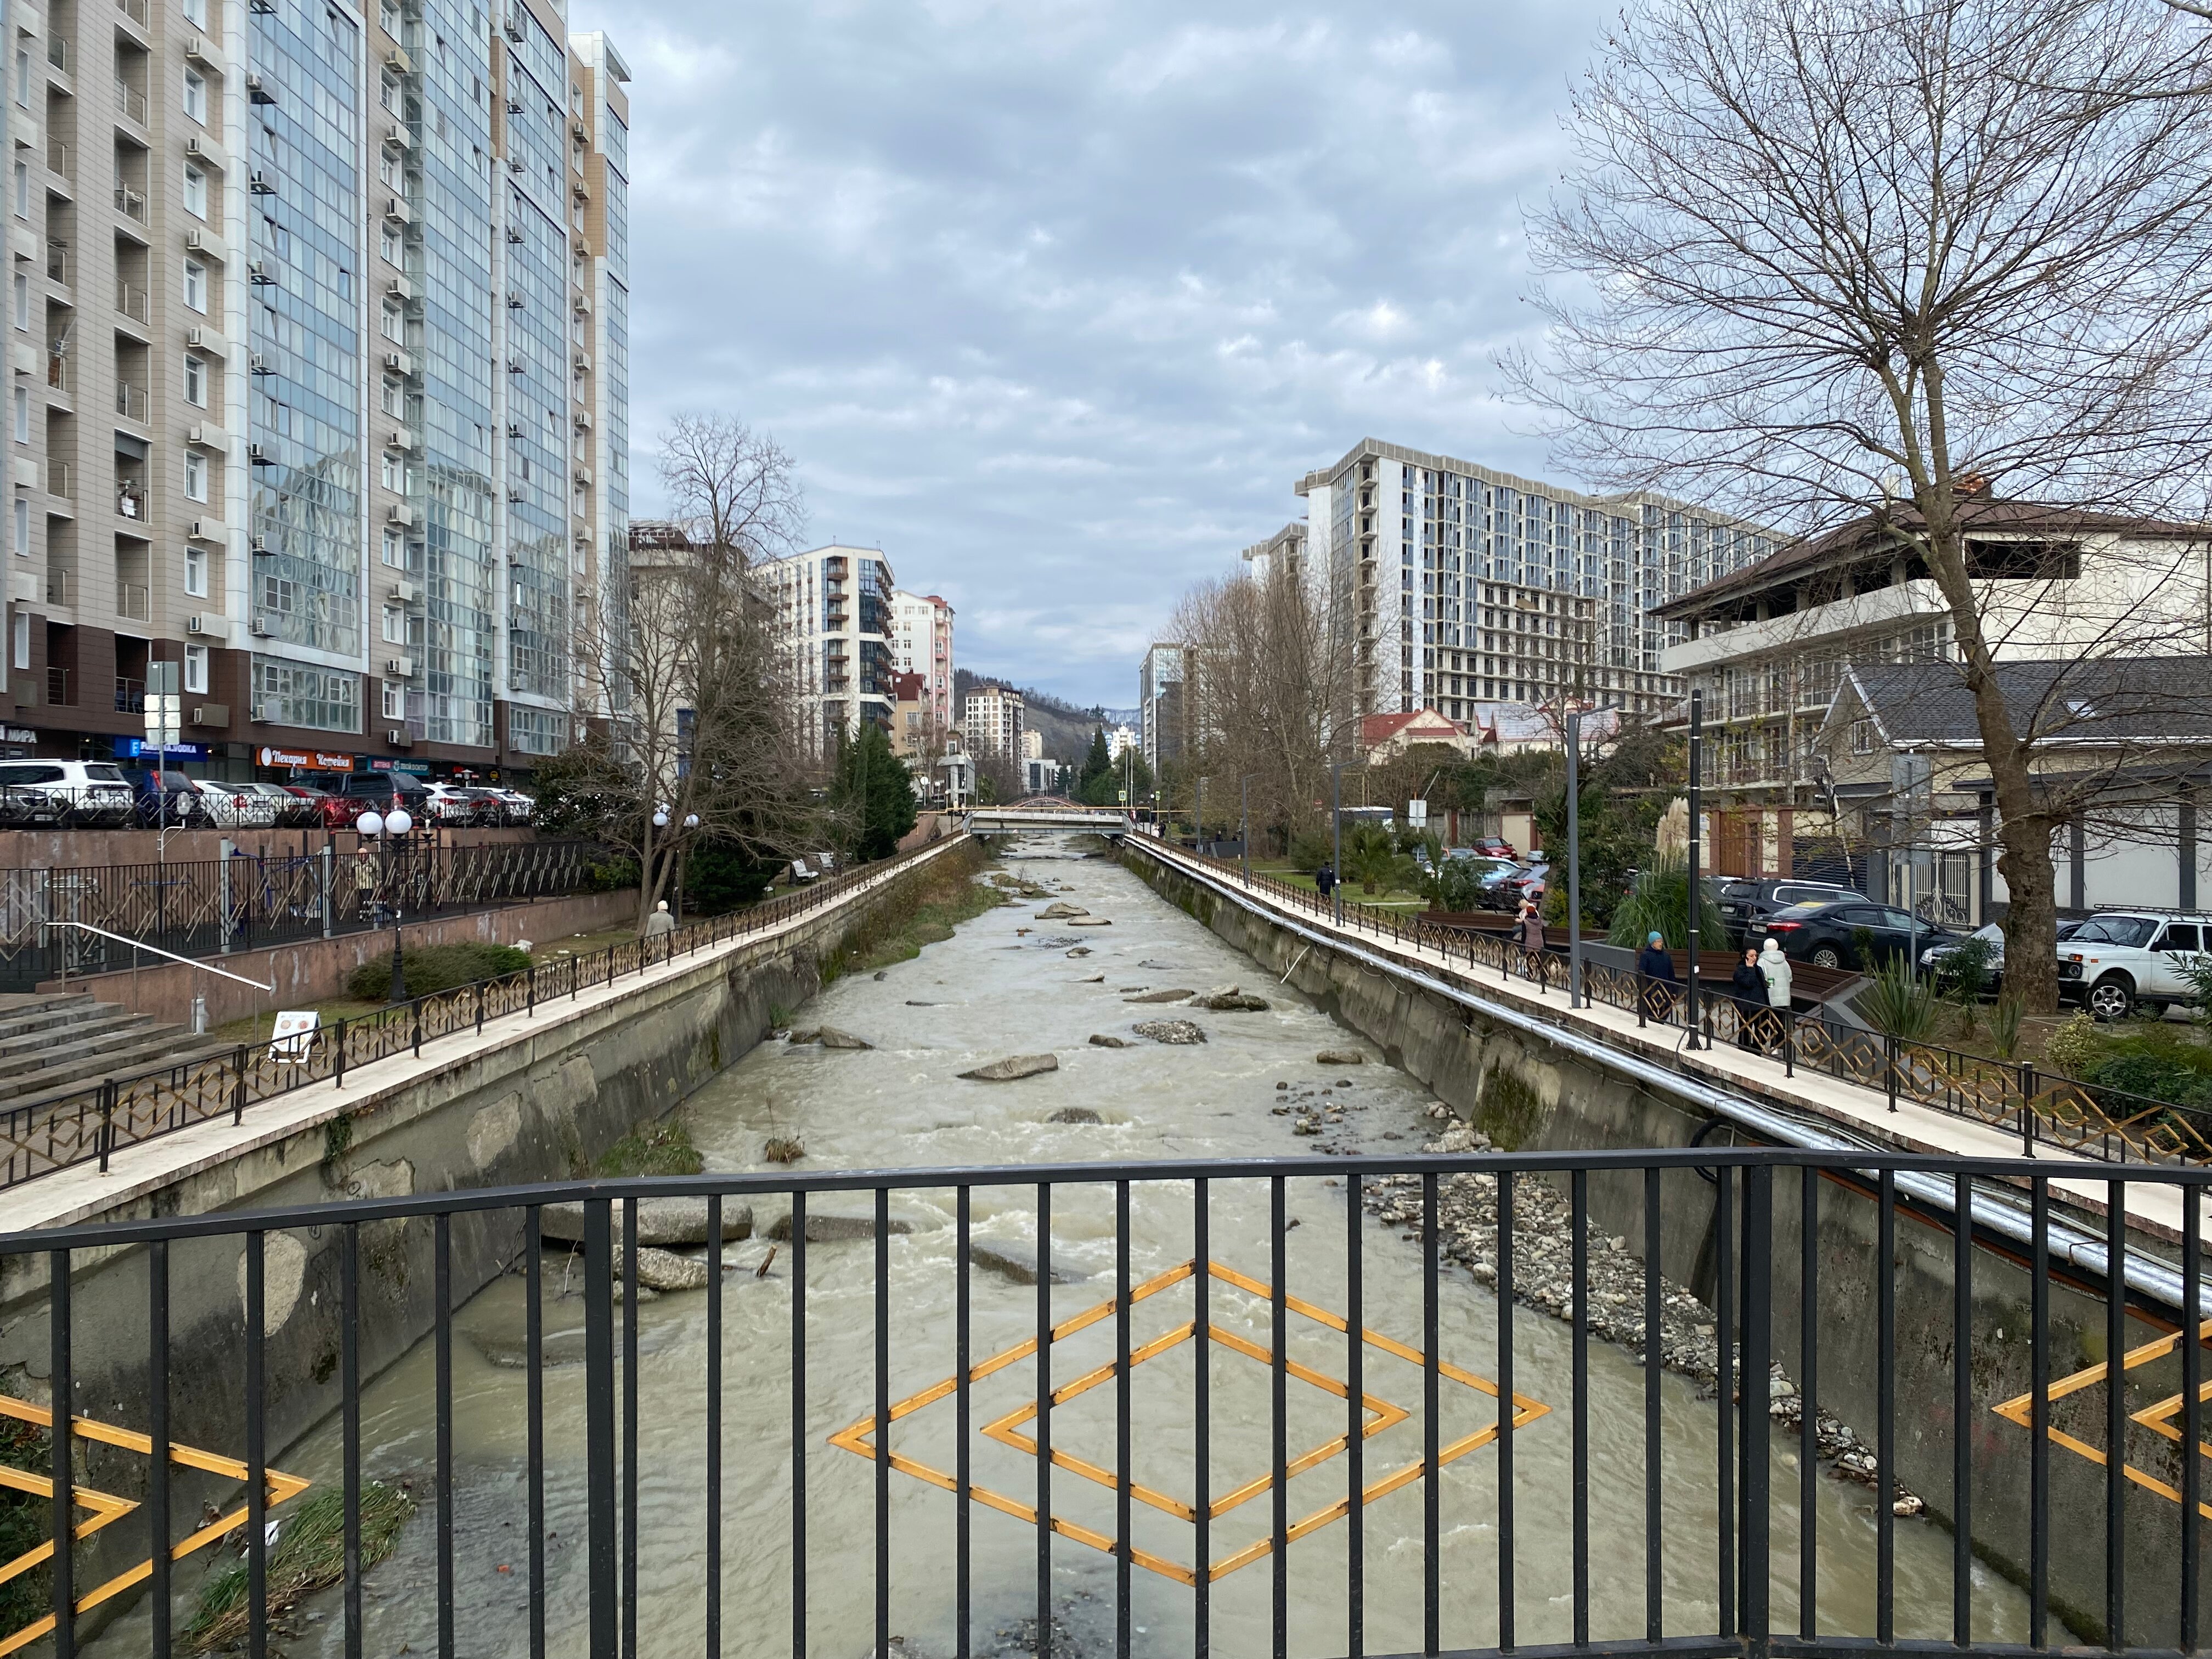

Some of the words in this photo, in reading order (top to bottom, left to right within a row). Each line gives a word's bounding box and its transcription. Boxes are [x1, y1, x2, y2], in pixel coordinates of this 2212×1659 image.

[8, 729, 38, 743] МИРА
[272, 750, 307, 766] Пекарня
[317, 753, 349, 767] Коейня
